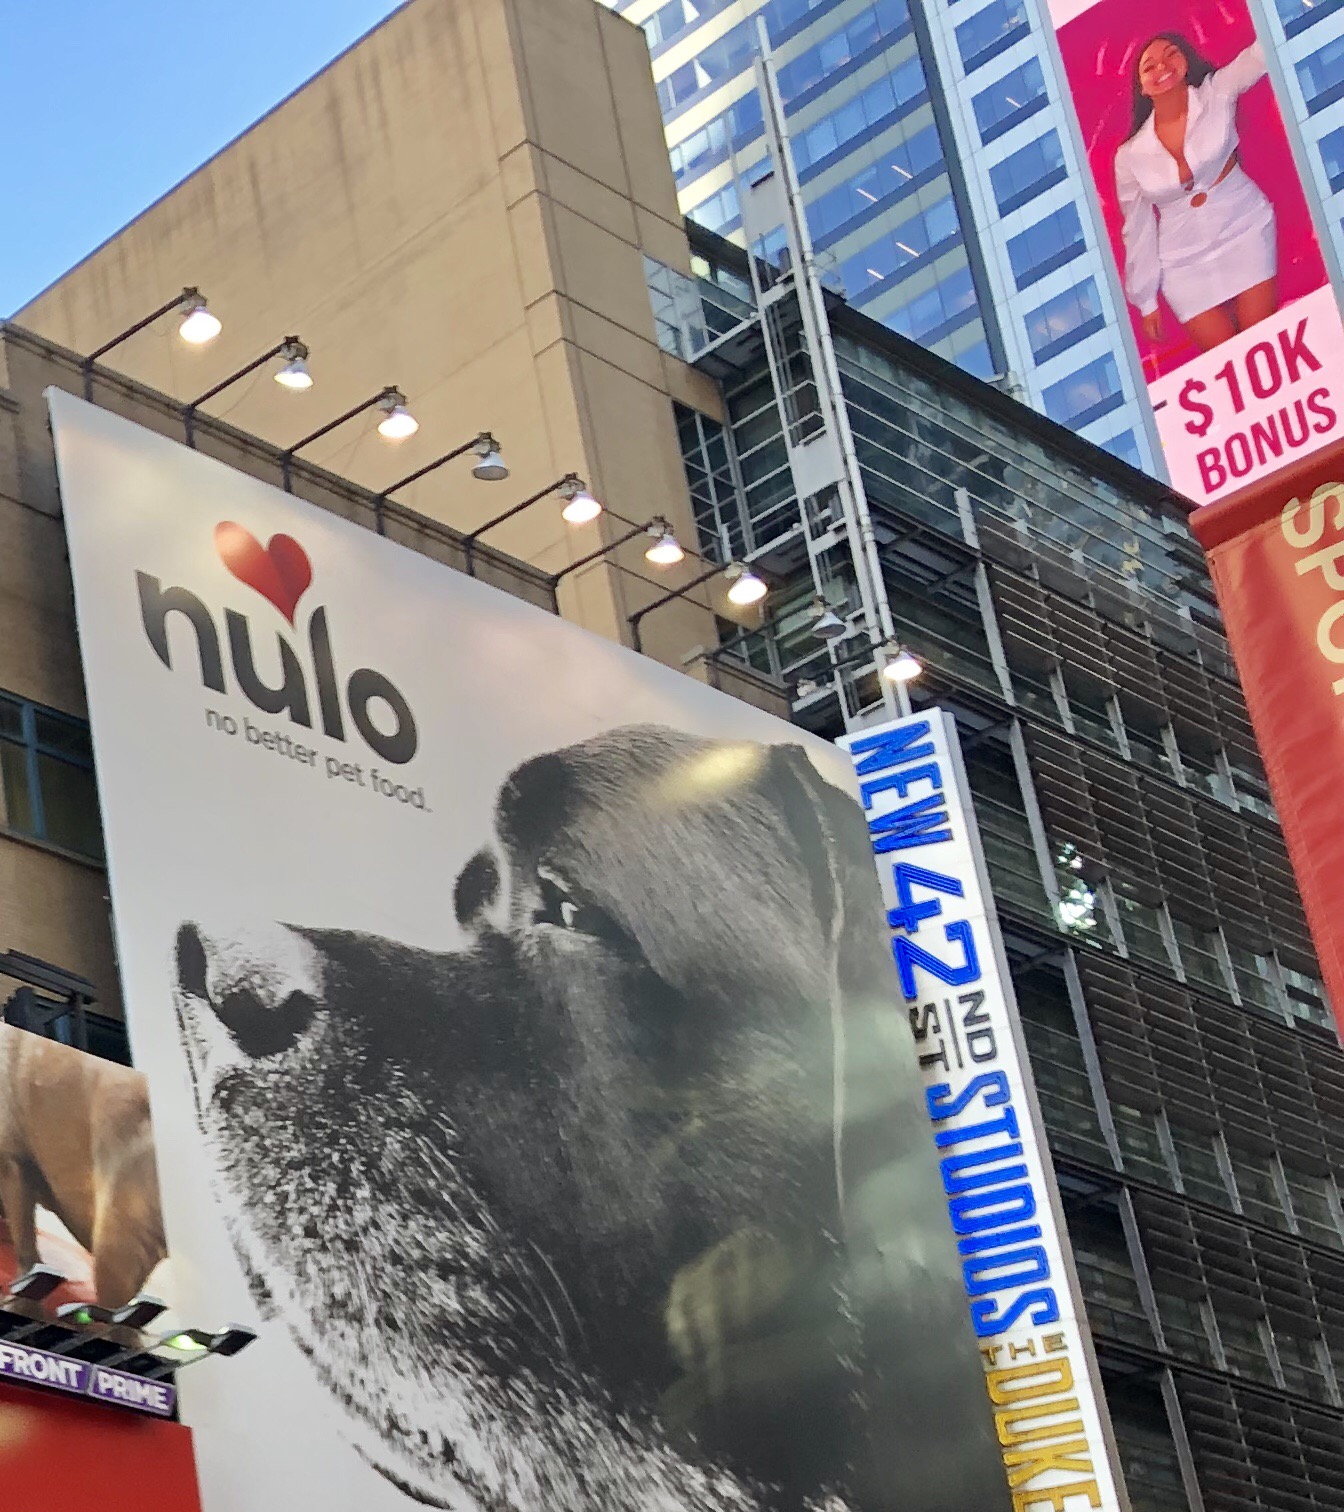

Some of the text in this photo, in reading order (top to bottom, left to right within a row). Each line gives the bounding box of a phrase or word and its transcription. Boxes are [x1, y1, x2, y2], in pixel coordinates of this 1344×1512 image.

[1179, 317, 1322, 437] $10K
[1196, 387, 1338, 494] BONUS
[135, 570, 418, 764] nulo
[204, 707, 238, 736] no
[243, 717, 318, 767] better
[326, 751, 366, 788] pet
[849, 719, 953, 854] NEW
[925, 1070, 1062, 1337] STUDIOS
[98, 1371, 169, 1410] PRIME
[978, 1332, 1068, 1367] THE
